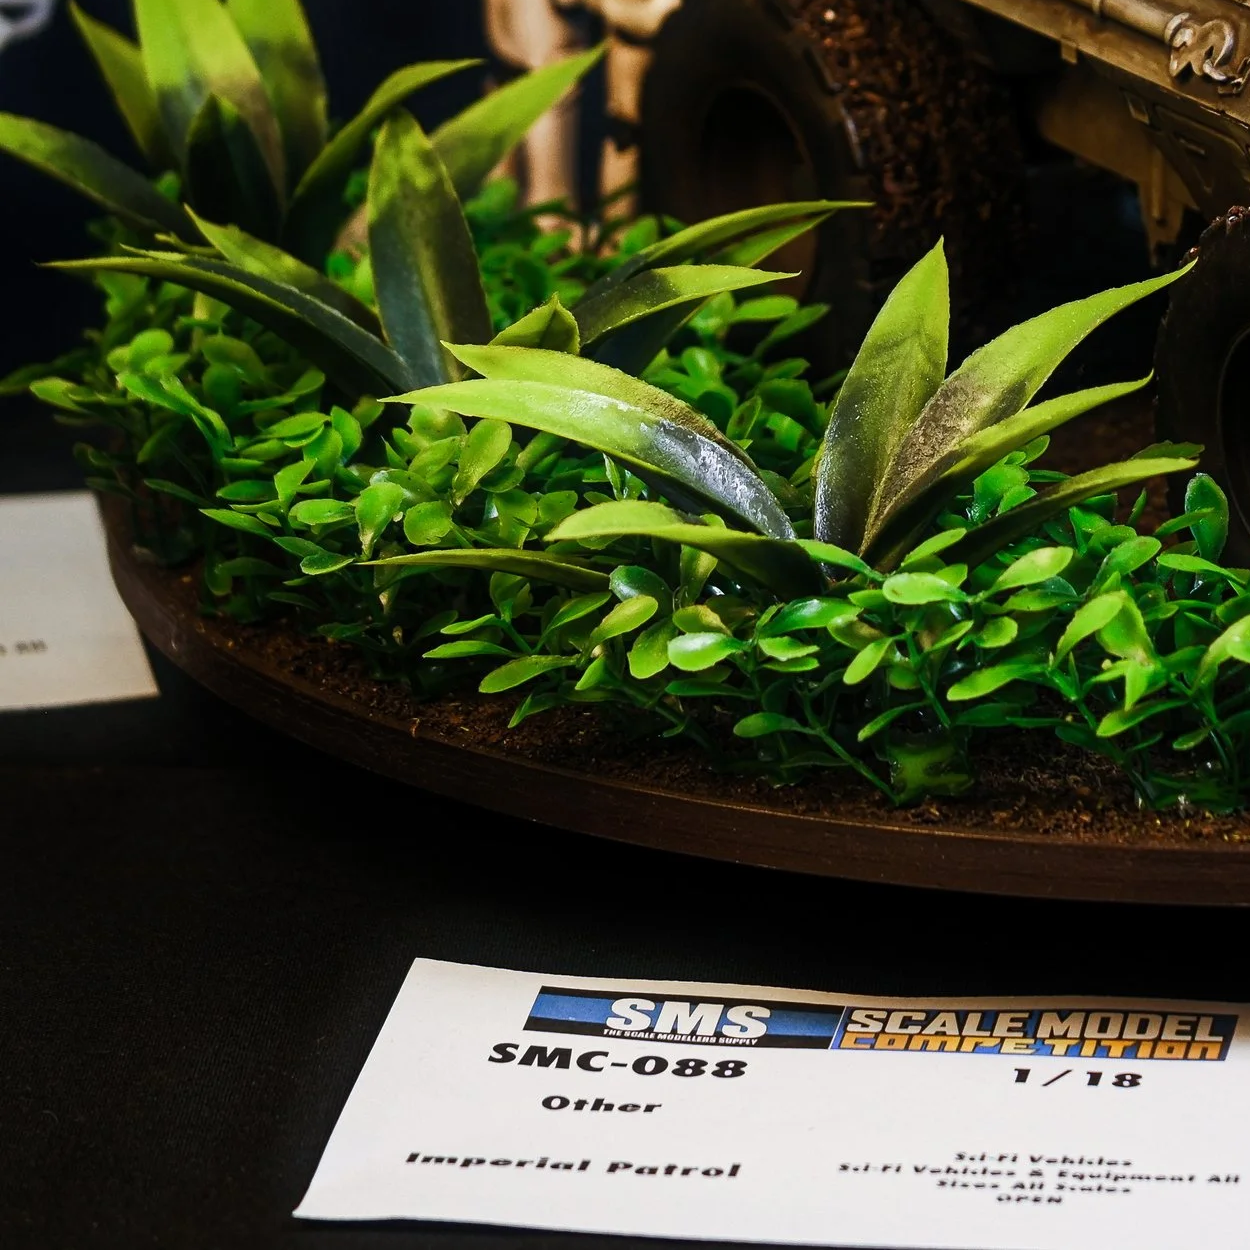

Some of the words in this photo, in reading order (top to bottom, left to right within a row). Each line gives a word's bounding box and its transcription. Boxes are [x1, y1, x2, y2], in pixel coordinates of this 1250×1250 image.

[606, 998, 771, 1039] SMS
[846, 1009, 1033, 1038] SCALE
[1036, 1011, 1224, 1042] MODEL
[603, 1028, 622, 1037] THE
[624, 1030, 655, 1040] SCALE
[657, 1033, 717, 1044] MODELLERS
[718, 1037, 758, 1046] SUPPLY
[488, 1042, 748, 1078] SMC-088
[1013, 1068, 1143, 1088] 1/18
[541, 1095, 663, 1113] Other
[405, 1152, 592, 1172] Imperial
[606, 1161, 742, 1177] Patrol
